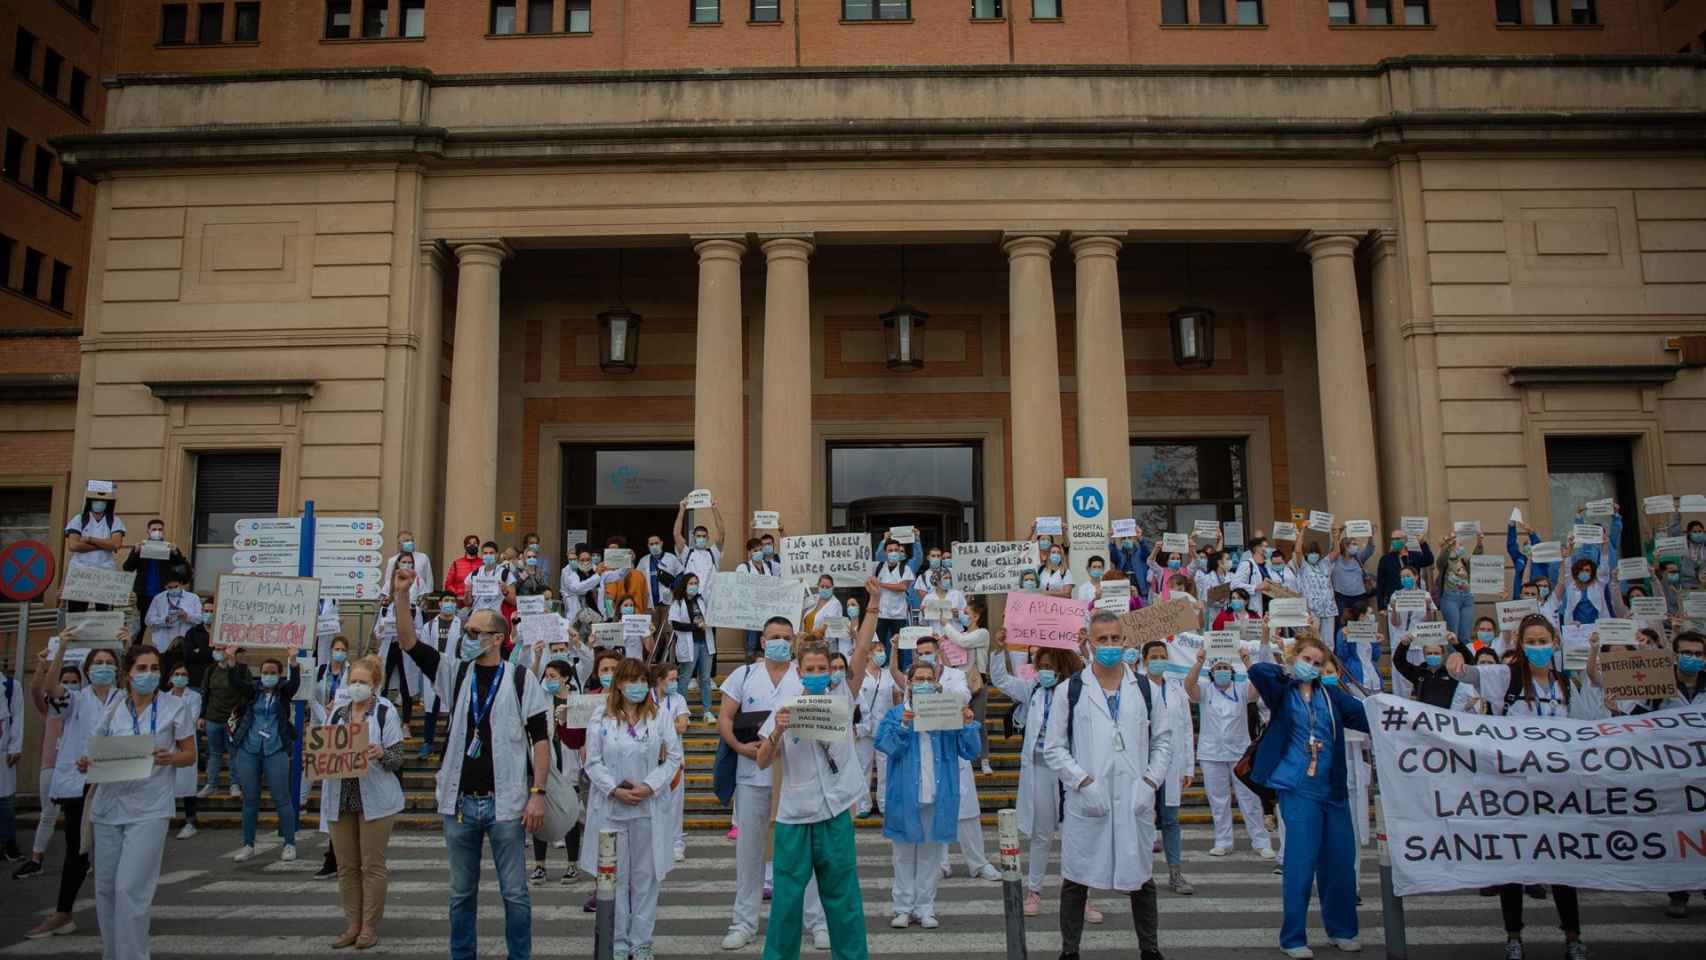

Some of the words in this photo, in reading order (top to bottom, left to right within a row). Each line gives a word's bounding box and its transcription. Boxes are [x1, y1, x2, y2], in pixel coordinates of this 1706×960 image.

[1076, 496, 1100, 511] 1A
[971, 558, 989, 568] CON
[256, 582, 304, 597] MALA
[1029, 600, 1086, 617] APLAUSOS
[1011, 628, 1080, 642] DERECHOS
[1601, 656, 1674, 672] INTERINATGES
[816, 724, 846, 732] TRABAJO
[1381, 706, 1706, 743] #APLAUSOSENDE
[309, 723, 361, 751] STOP
[304, 751, 368, 779] RECORTES
[1398, 747, 1478, 774] CON
[1497, 749, 1570, 774] LAS
[1434, 787, 1658, 818] LABORALES
[1404, 830, 1667, 863] SANITARI@S
